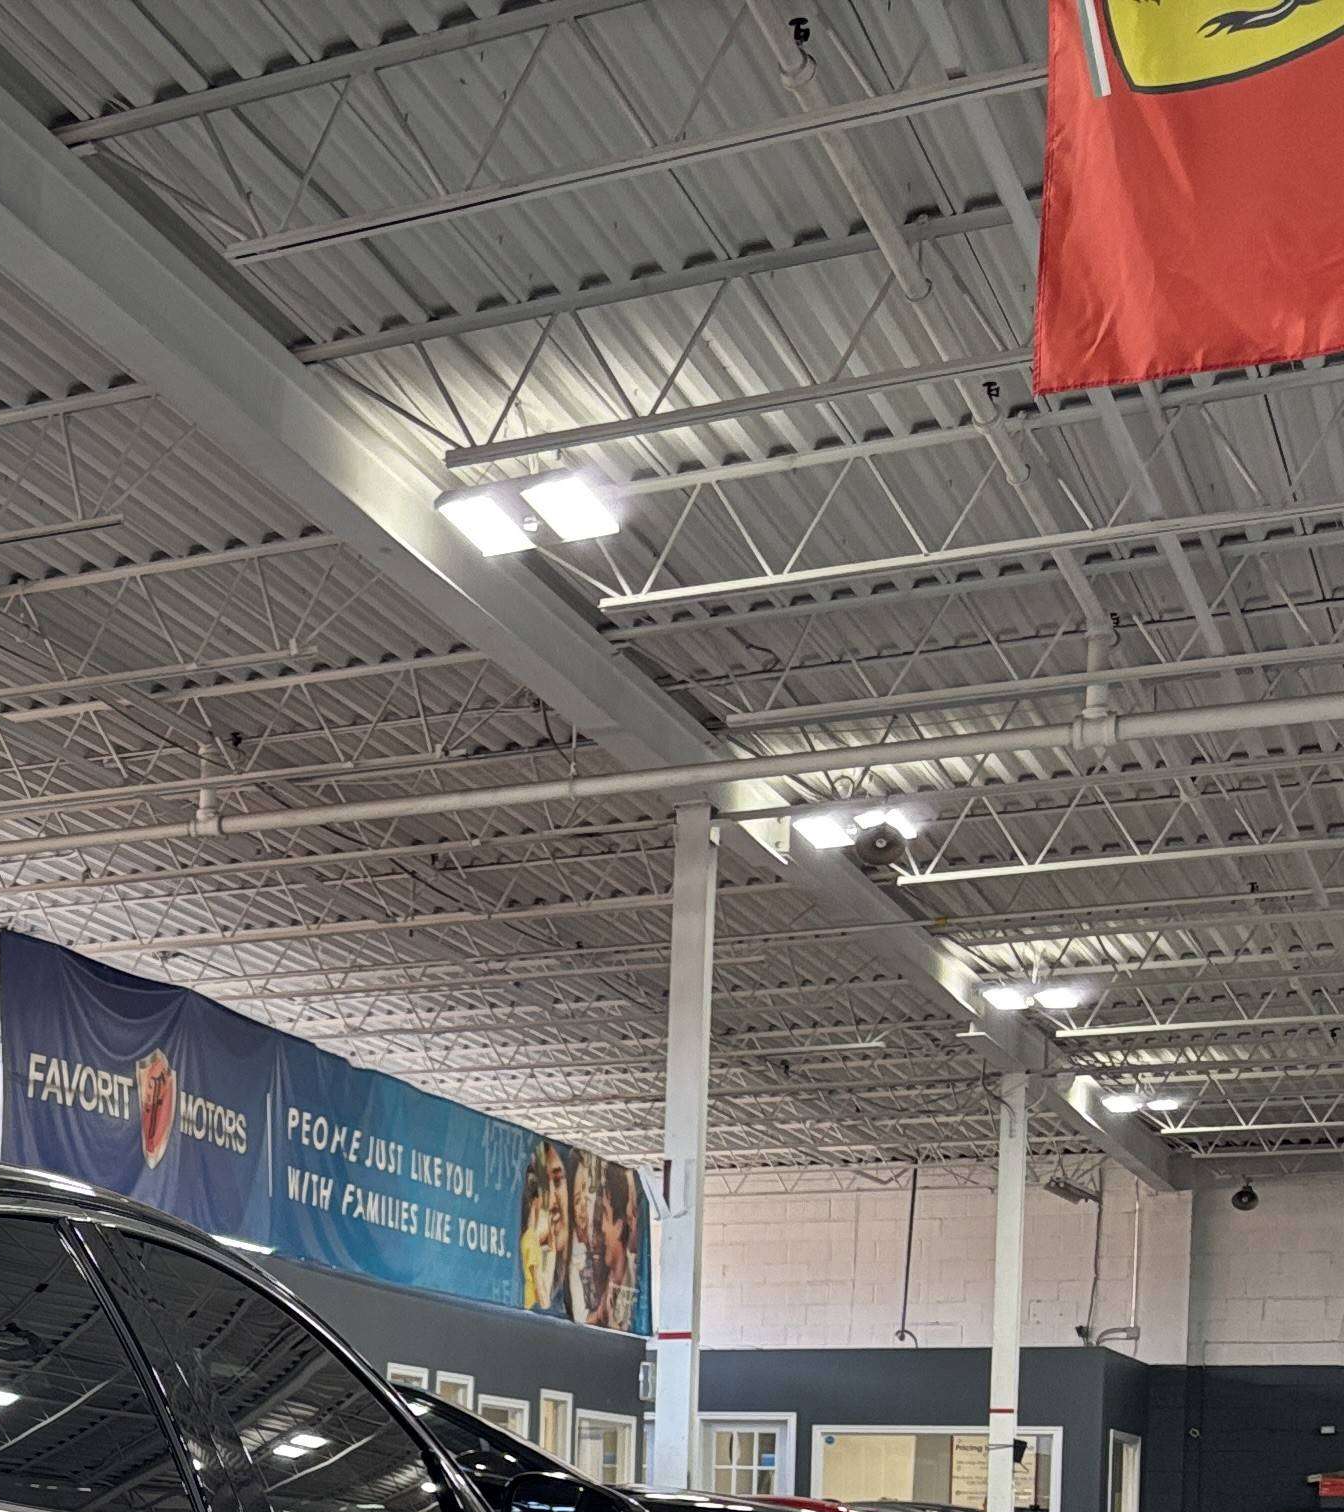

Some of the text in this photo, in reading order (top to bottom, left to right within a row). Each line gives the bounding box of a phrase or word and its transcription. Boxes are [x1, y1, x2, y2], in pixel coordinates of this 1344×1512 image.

[27, 1052, 134, 1121] FAVORIT
[179, 1091, 248, 1154] MOTORS
[364, 1135, 405, 1176] JUST
[410, 1149, 442, 1188] LIKE
[287, 1165, 512, 1259] WITH FAMILIES LIKE YOURS.
